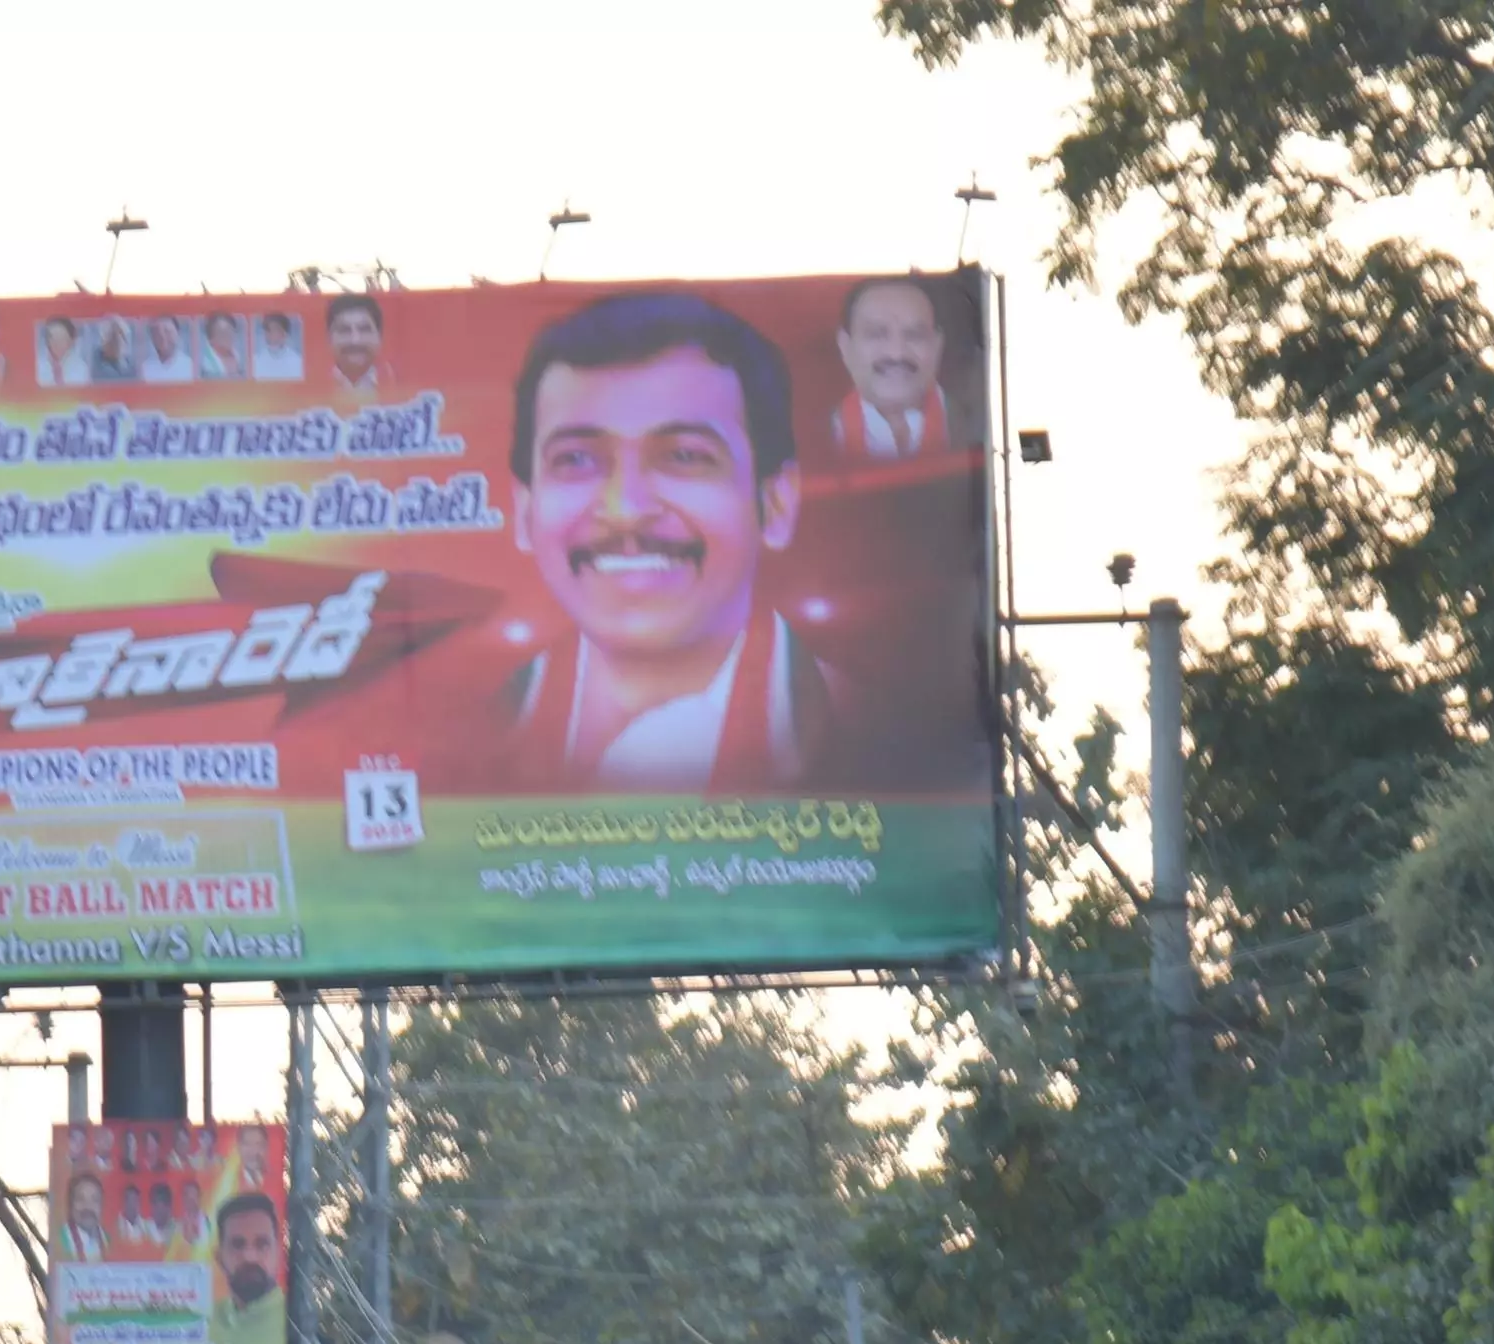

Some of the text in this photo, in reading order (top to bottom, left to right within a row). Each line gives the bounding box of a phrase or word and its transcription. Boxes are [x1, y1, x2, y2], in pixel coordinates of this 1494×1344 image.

[125, 410, 339, 462] తెలంగాణకు
[311, 474, 392, 531] లేదు
[88, 754, 119, 783] OF
[131, 751, 173, 782] THE
[184, 748, 274, 785] PEOPLE
[359, 784, 408, 819] 13
[825, 798, 882, 852] రెడ్డి
[84, 845, 110, 868] to
[117, 830, 197, 867] Messi
[28, 880, 126, 917] BALL
[139, 876, 276, 912] MATCH
[130, 926, 192, 960] V/S
[204, 924, 304, 959] Messi
